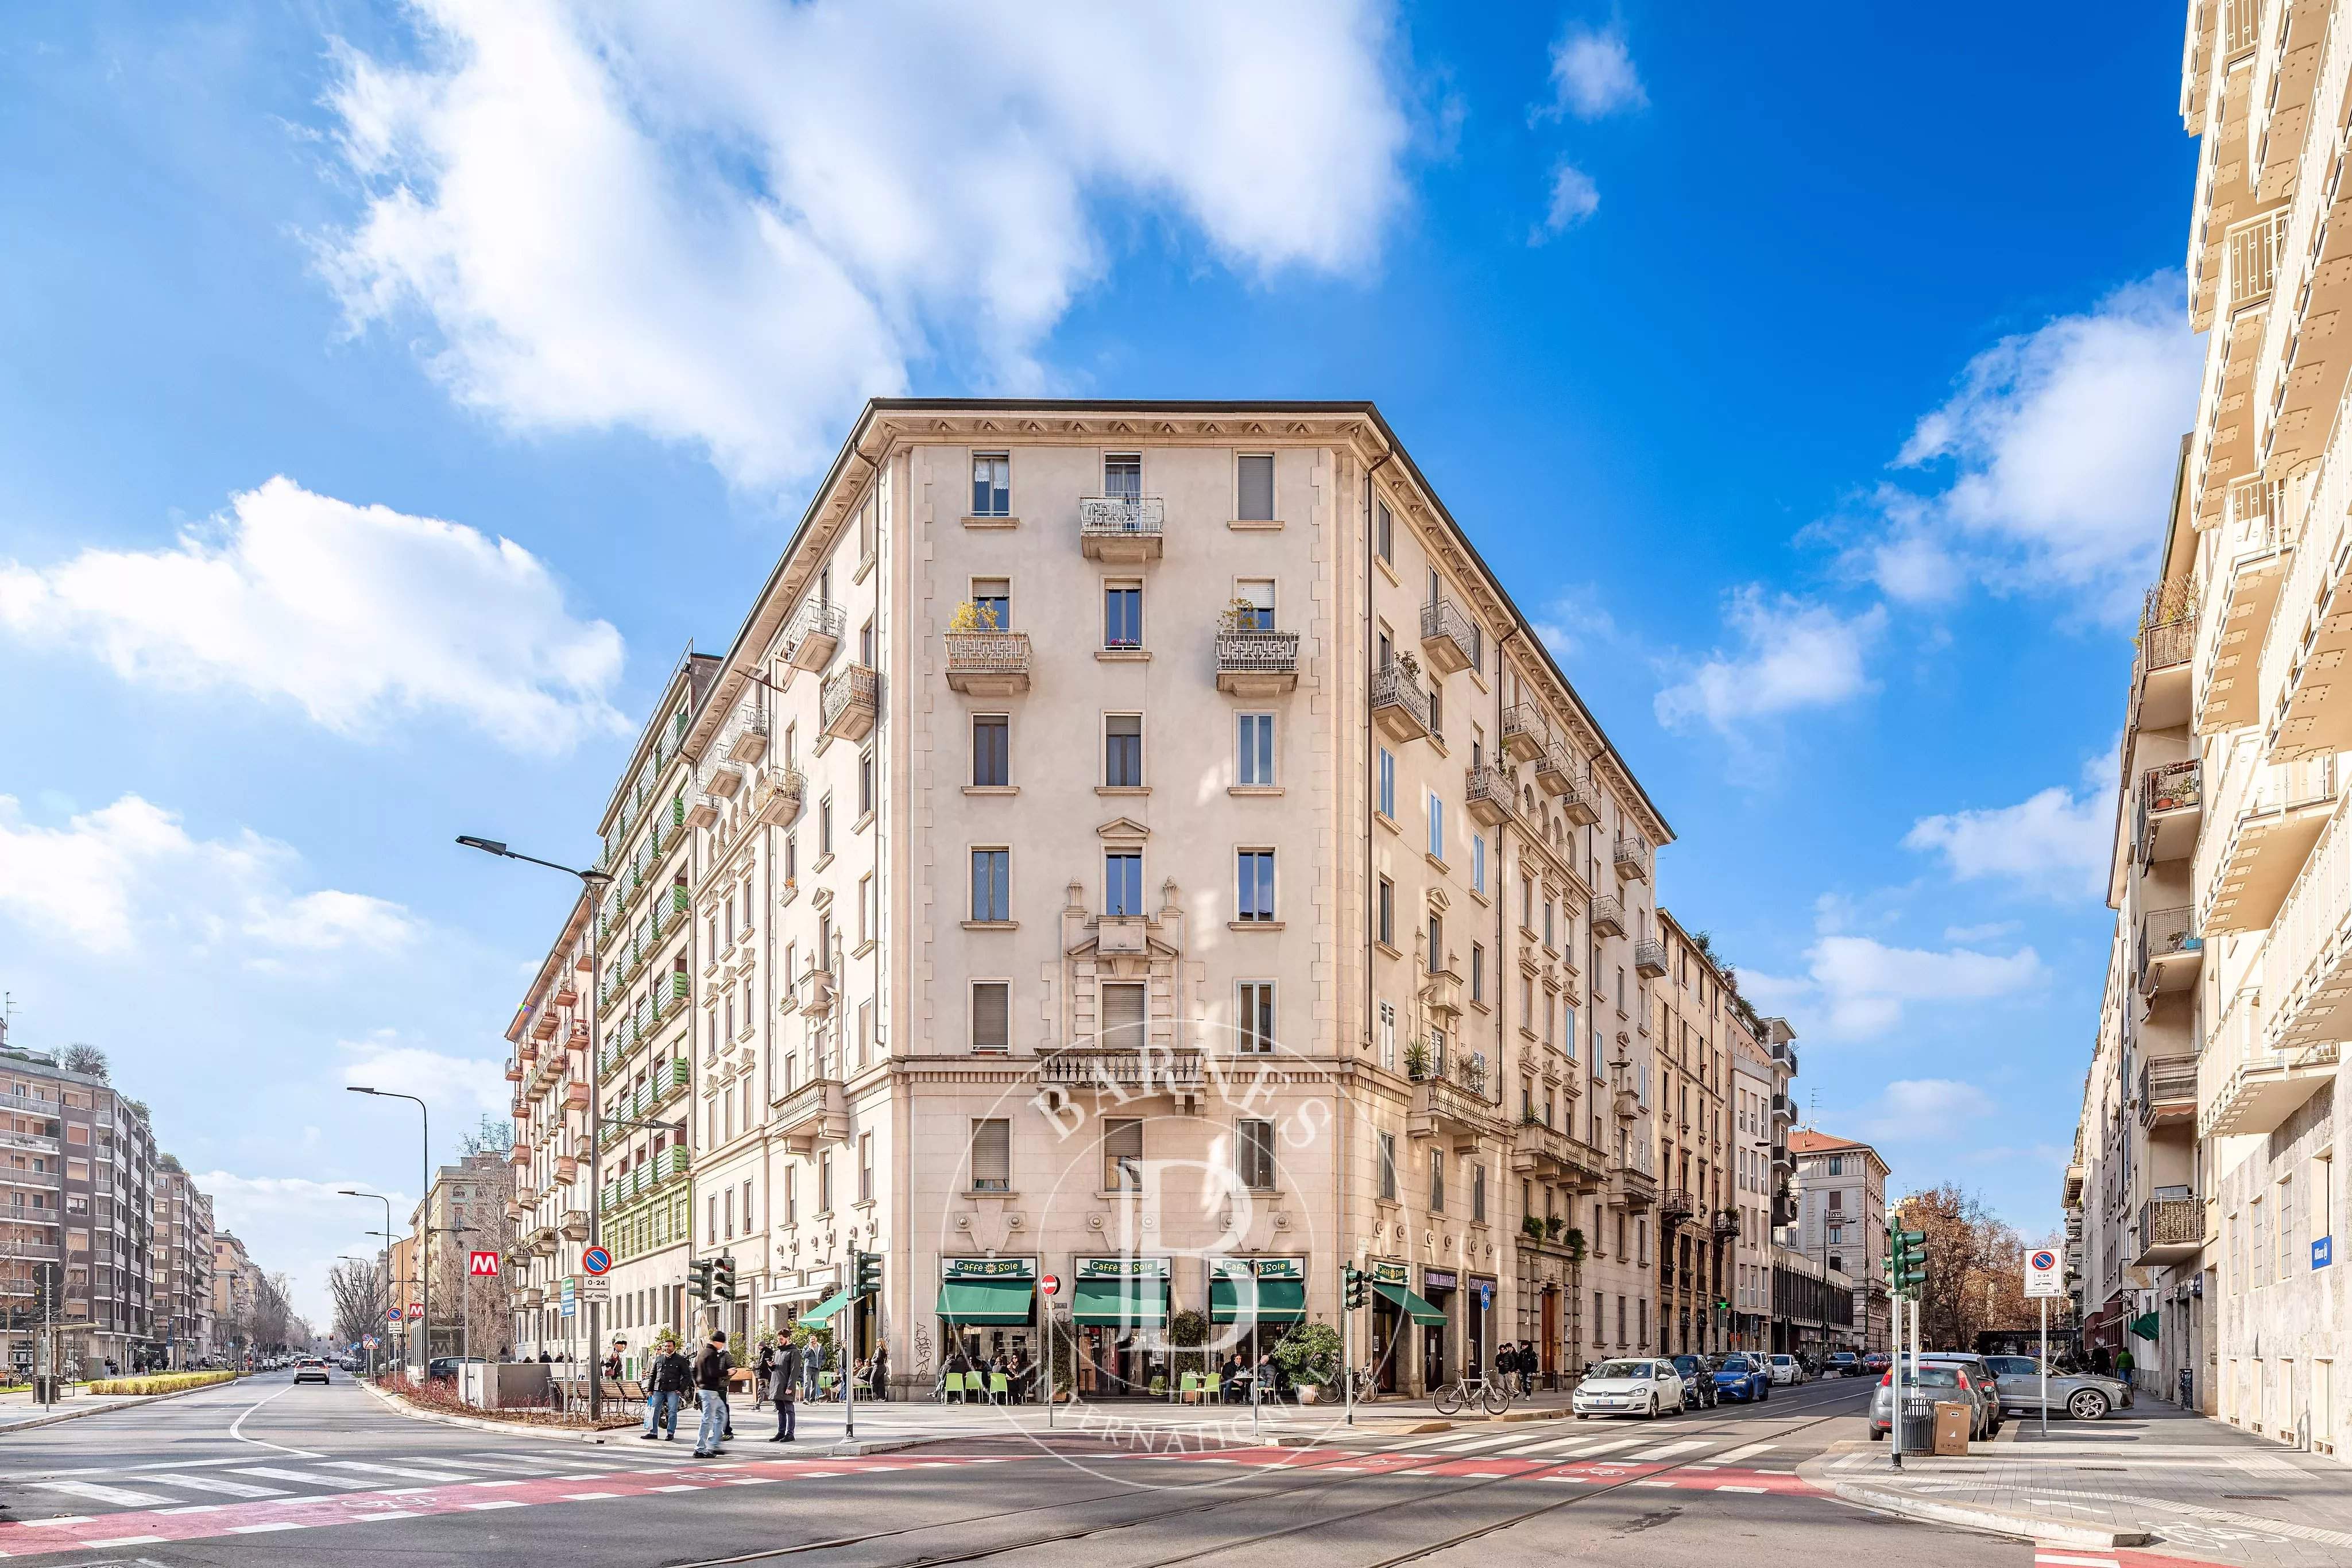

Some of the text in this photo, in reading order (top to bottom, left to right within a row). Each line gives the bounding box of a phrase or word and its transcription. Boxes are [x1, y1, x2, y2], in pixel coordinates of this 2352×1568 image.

[471, 1255, 497, 1272] M
[957, 1262, 983, 1272] Caffè
[999, 1263, 1018, 1272] Sole
[1092, 1262, 1118, 1272] Caffè
[1133, 1263, 1153, 1272] Sole
[1224, 1262, 1285, 1272] Caff Sole
[1379, 1265, 1390, 1276] Caffè
[1395, 1269, 1403, 1278] Sole
[410, 1305, 424, 1315] M
